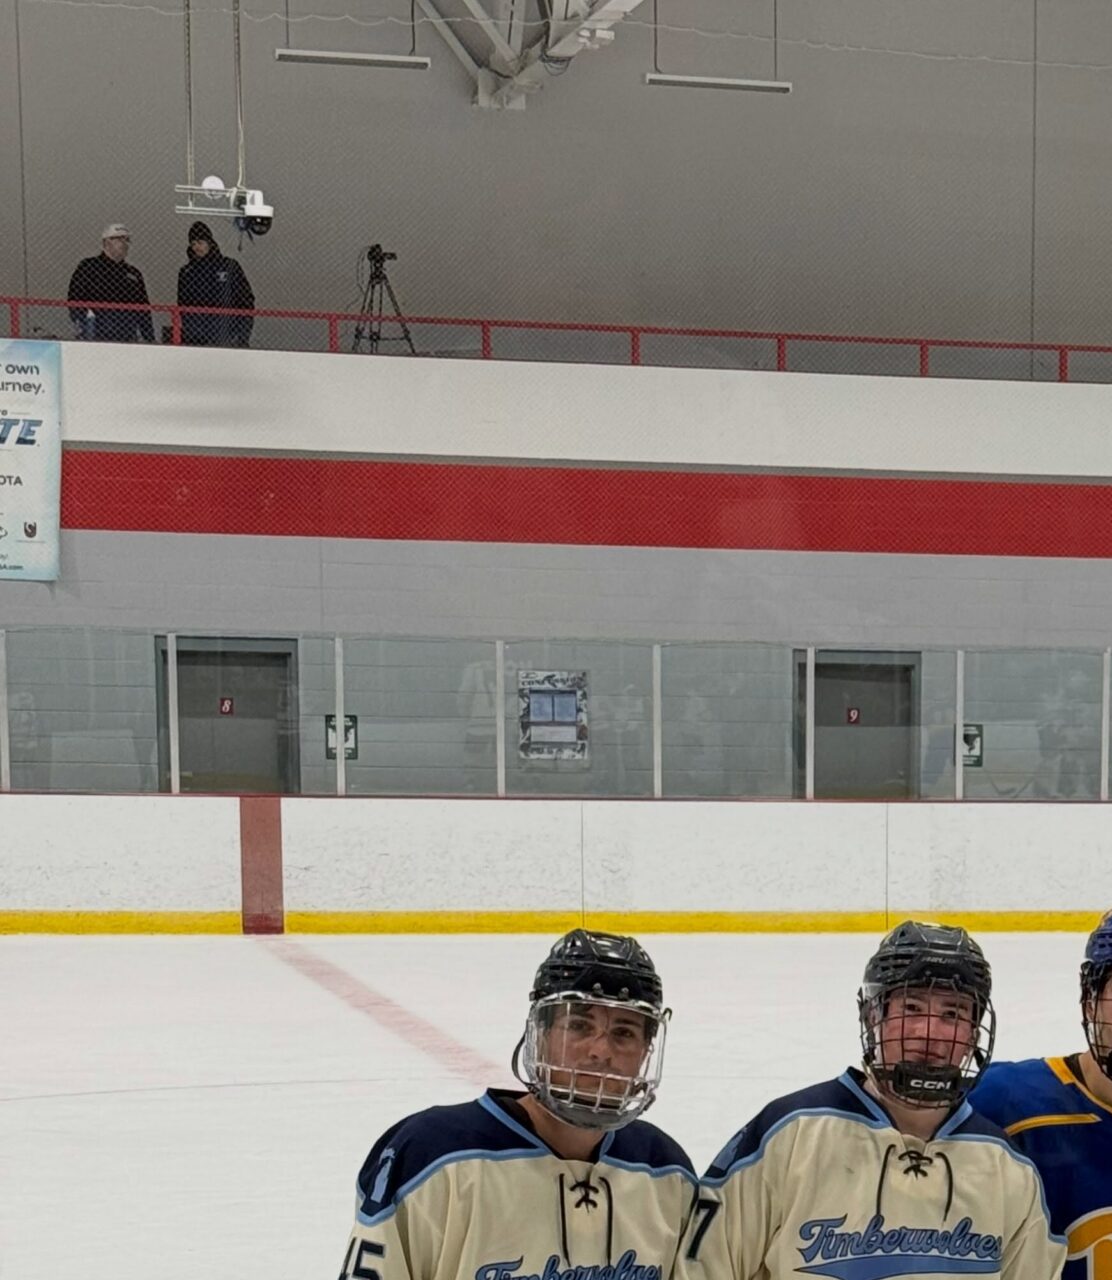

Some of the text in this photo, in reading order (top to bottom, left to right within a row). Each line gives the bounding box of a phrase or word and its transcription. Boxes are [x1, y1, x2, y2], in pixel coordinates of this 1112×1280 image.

[5, 364, 40, 375] own
[221, 699, 232, 713] 8
[849, 709, 859, 722] 9
[909, 1079, 951, 1090] CCM
